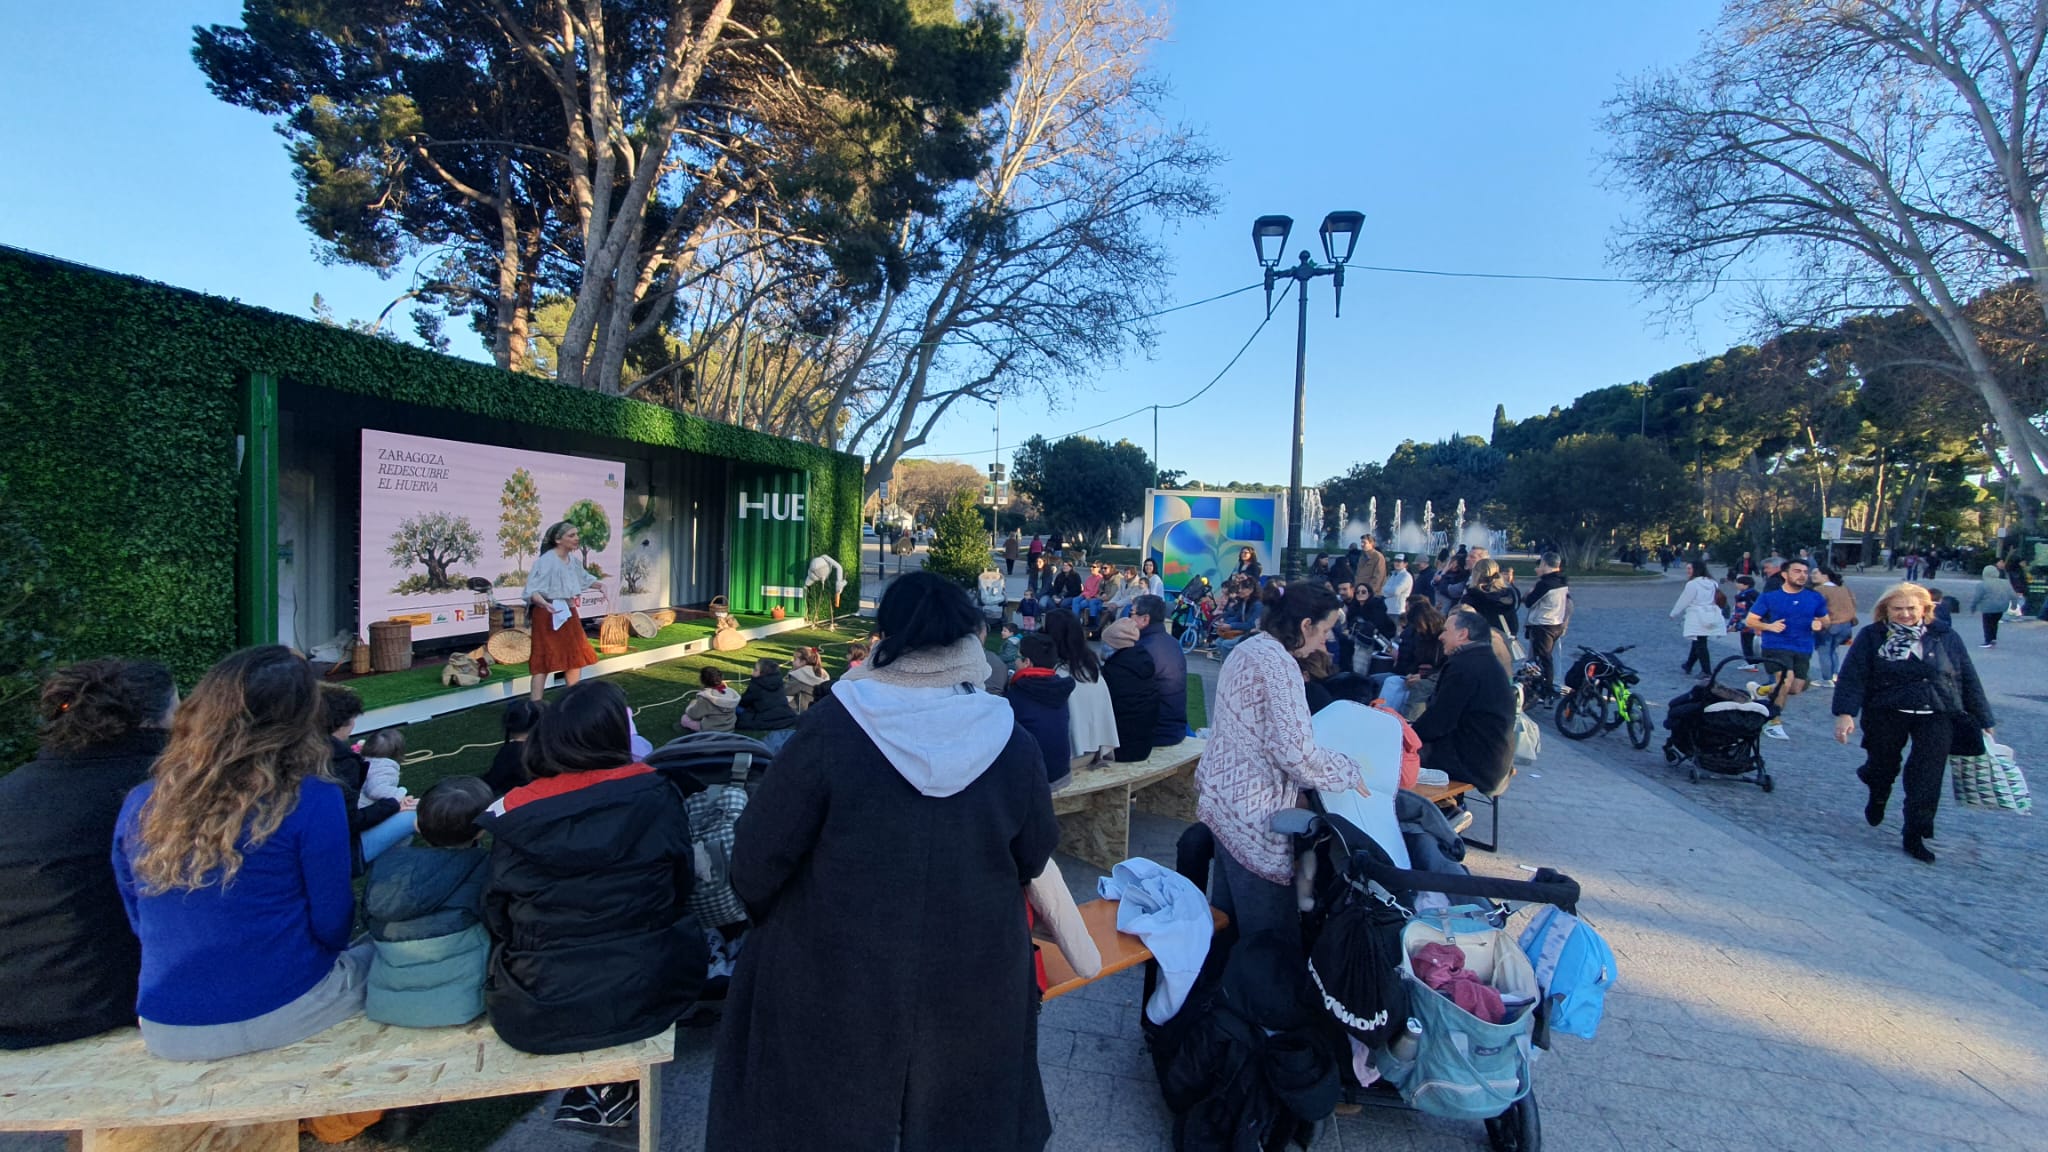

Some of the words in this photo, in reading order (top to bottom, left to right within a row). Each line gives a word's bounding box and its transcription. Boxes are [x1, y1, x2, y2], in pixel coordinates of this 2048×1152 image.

[378, 449, 445, 465] ZARAGOZA
[377, 463, 450, 480] REDESCUBRE
[377, 478, 392, 490] EL
[394, 479, 439, 492] HUERVA
[739, 492, 804, 521] HUE
